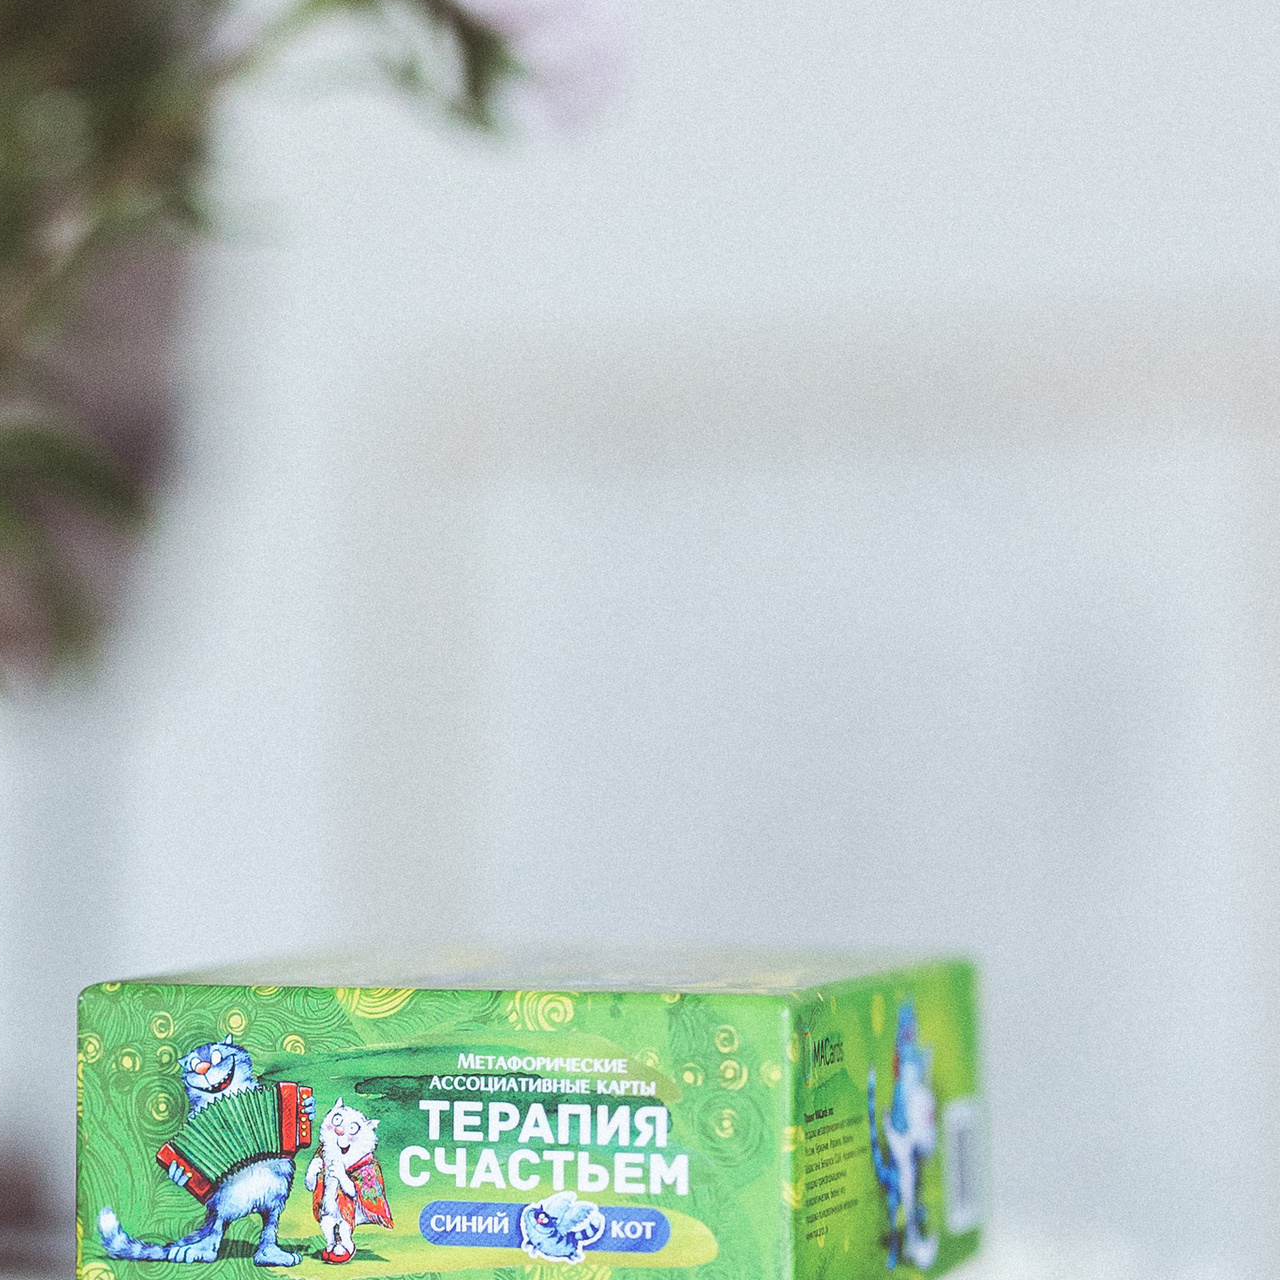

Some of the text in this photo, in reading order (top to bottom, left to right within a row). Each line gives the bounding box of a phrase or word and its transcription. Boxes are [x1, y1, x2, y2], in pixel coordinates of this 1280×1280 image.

[457, 1052, 628, 1074] МЕТАФОРИЧЕСКИЕ
[428, 1075, 657, 1096] АССОЦИАТИВНЫЕ КАРТЫ
[418, 1099, 669, 1148] ТЕРАПИЯ
[398, 1144, 690, 1196] СЧАСТЬЕМ
[429, 1211, 656, 1240] СИНИЙ КОТ
